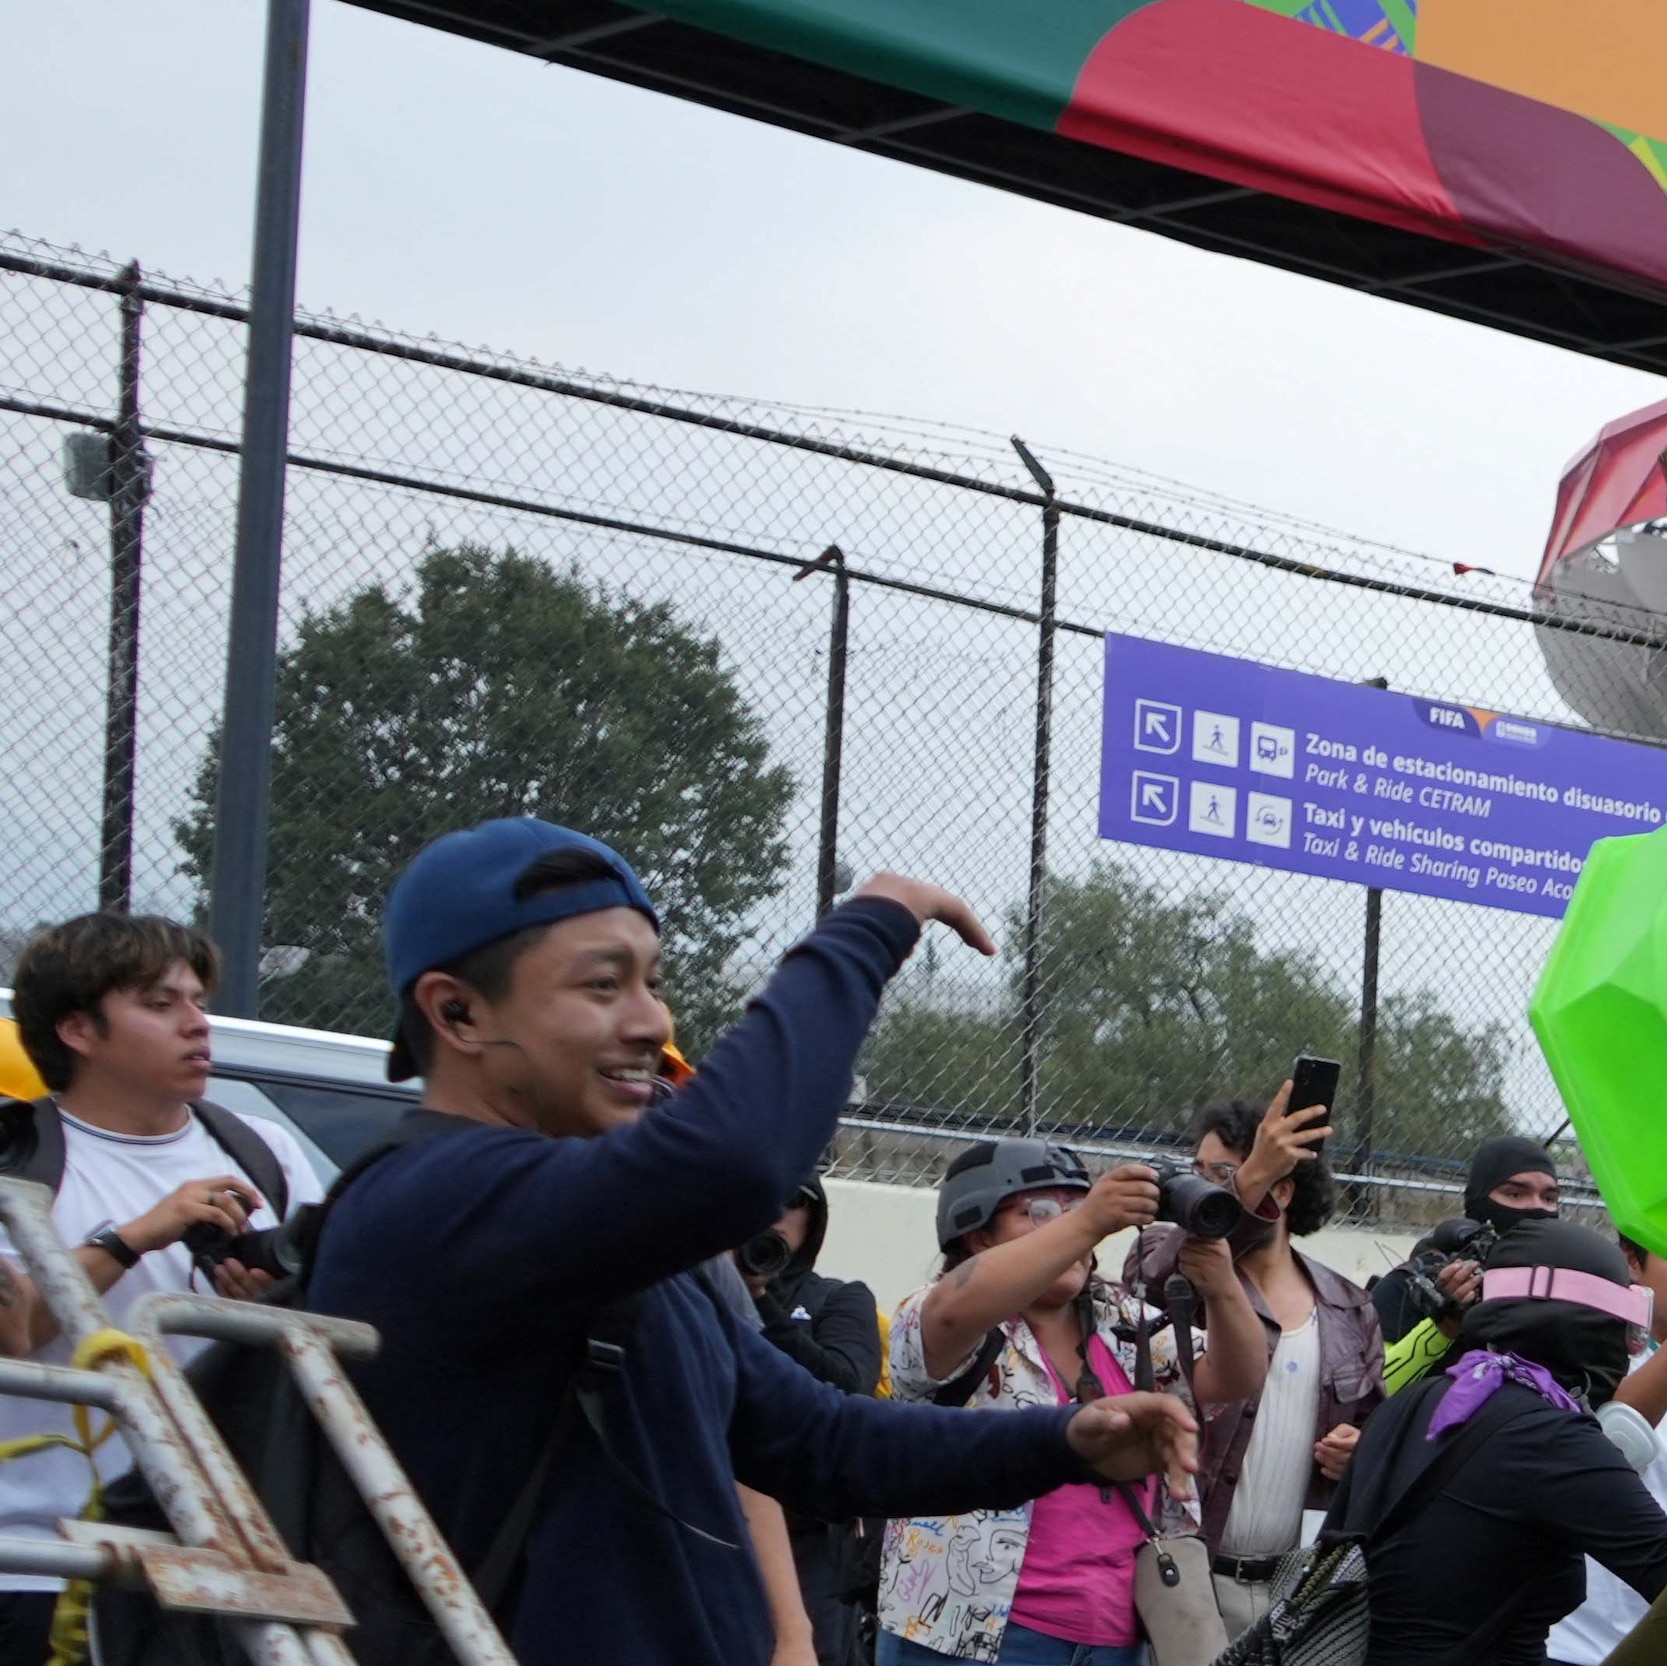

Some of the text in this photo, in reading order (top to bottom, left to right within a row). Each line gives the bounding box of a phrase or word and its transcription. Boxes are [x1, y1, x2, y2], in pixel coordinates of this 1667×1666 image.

[1429, 707, 1466, 730] FIFA
[1305, 763, 1492, 818] Park & Ride CETRAM
[1306, 732, 1358, 763] Zona
[1363, 745, 1388, 769] de
[1393, 753, 1559, 803] estacionamiento
[1563, 785, 1661, 824] disuasorio
[1303, 802, 1346, 829] Taxi
[1350, 816, 1365, 837] y
[1369, 818, 1465, 852] vehículos
[1304, 833, 1341, 858] Taxi
[1344, 841, 1359, 862] &
[1365, 844, 1405, 869] Ride
[1410, 853, 1481, 889] Sharing
[1485, 867, 1538, 894] Paseo
